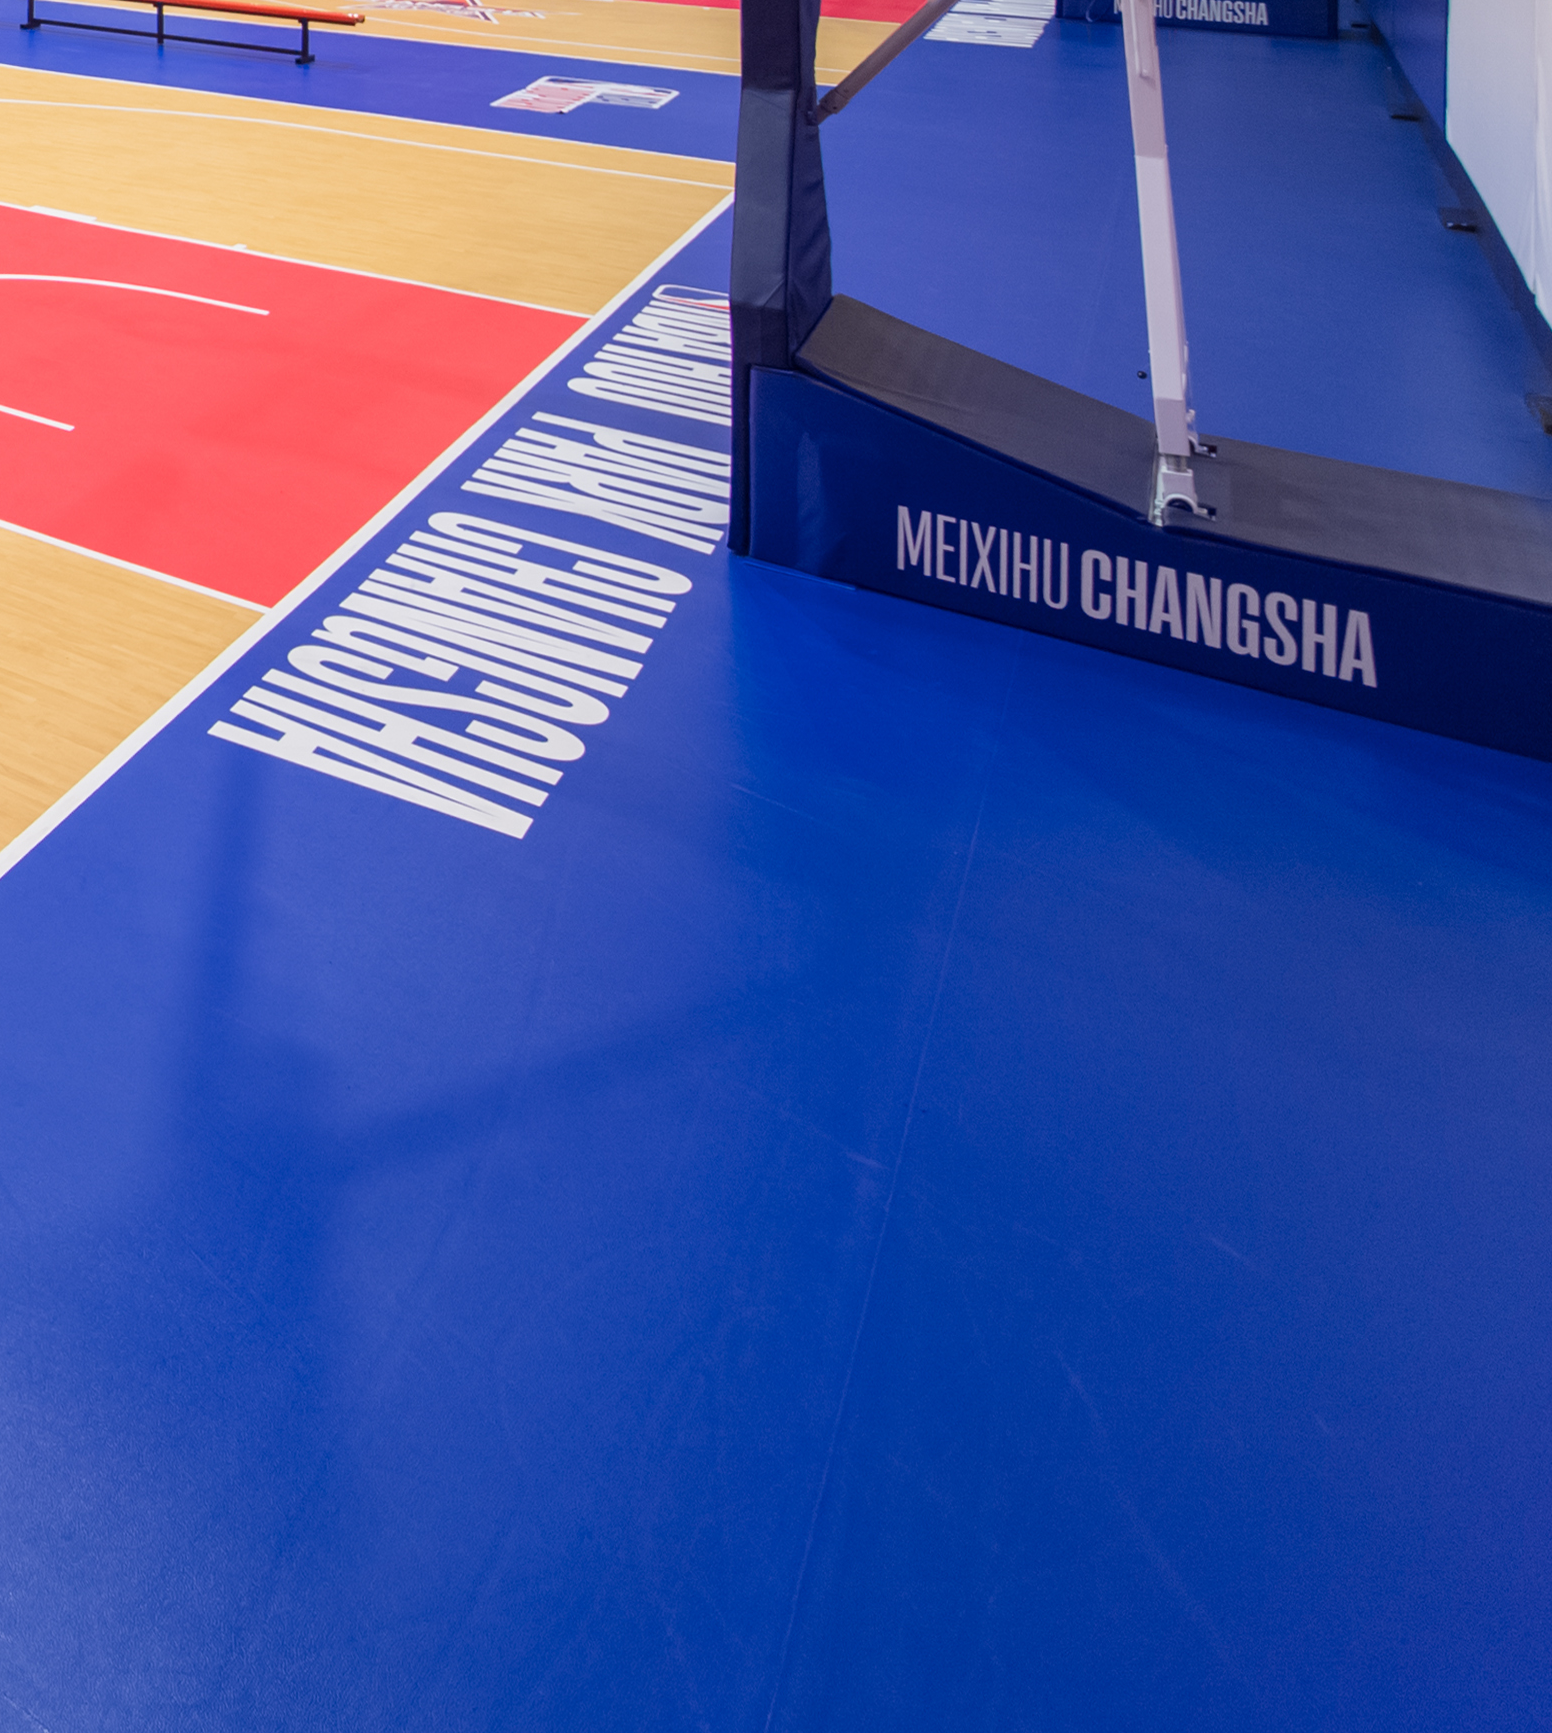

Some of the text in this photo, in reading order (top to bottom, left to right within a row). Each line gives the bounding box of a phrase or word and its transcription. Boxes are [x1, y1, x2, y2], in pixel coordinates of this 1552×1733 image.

[460, 411, 733, 555] PARK
[206, 511, 693, 840] CHANGSHA
[896, 504, 1378, 688] MEIXIHU CHANGSHA
